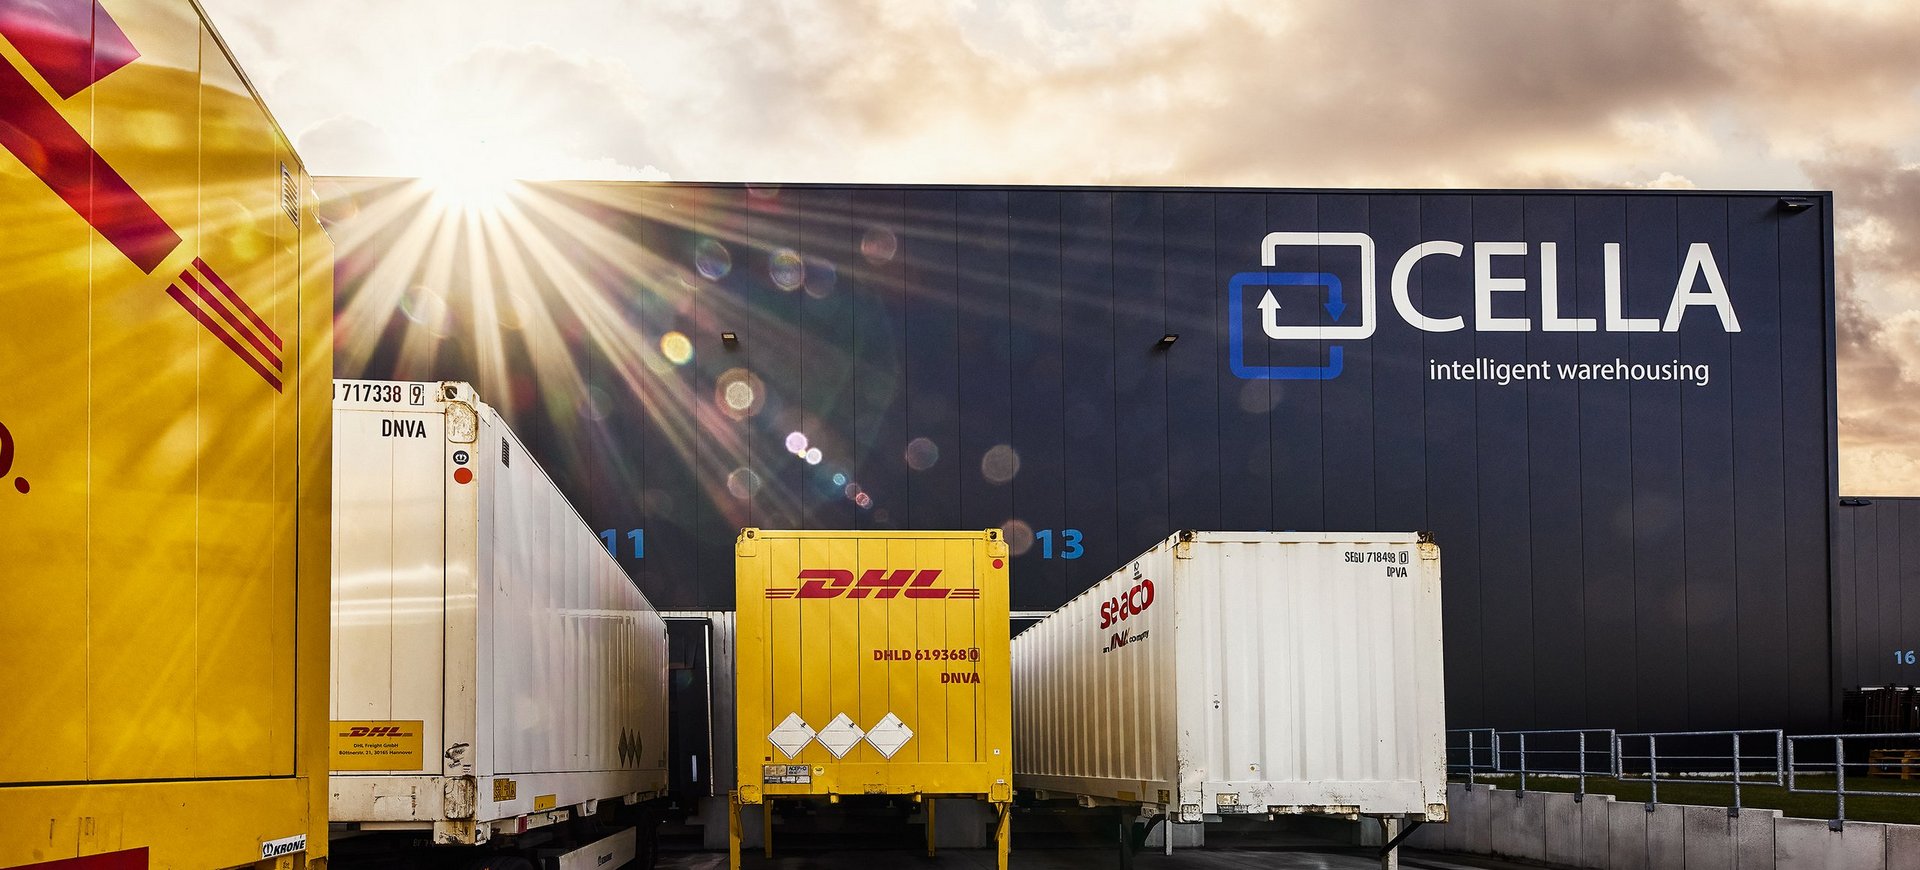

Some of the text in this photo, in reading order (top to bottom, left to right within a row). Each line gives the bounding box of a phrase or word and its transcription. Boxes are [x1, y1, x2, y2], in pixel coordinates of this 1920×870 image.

[1391, 240, 1742, 333] CELLA
[1430, 358, 1710, 386] intelligent warehousing
[342, 384, 402, 402] 717338
[411, 385, 423, 405] 9
[382, 419, 427, 438] DNVA
[600, 528, 644, 559] 11
[1036, 529, 1084, 558] 13
[1344, 551, 1365, 563] SEGU
[1367, 552, 1396, 563] 718498
[1386, 566, 1408, 577] DPVA
[794, 569, 953, 599] DHL
[1100, 579, 1155, 630] seaco
[873, 650, 912, 660] DHLD
[1894, 650, 1916, 665] 16
[941, 672, 981, 684] DNVA
[349, 727, 403, 737] DHL
[273, 840, 306, 855] KRONE
